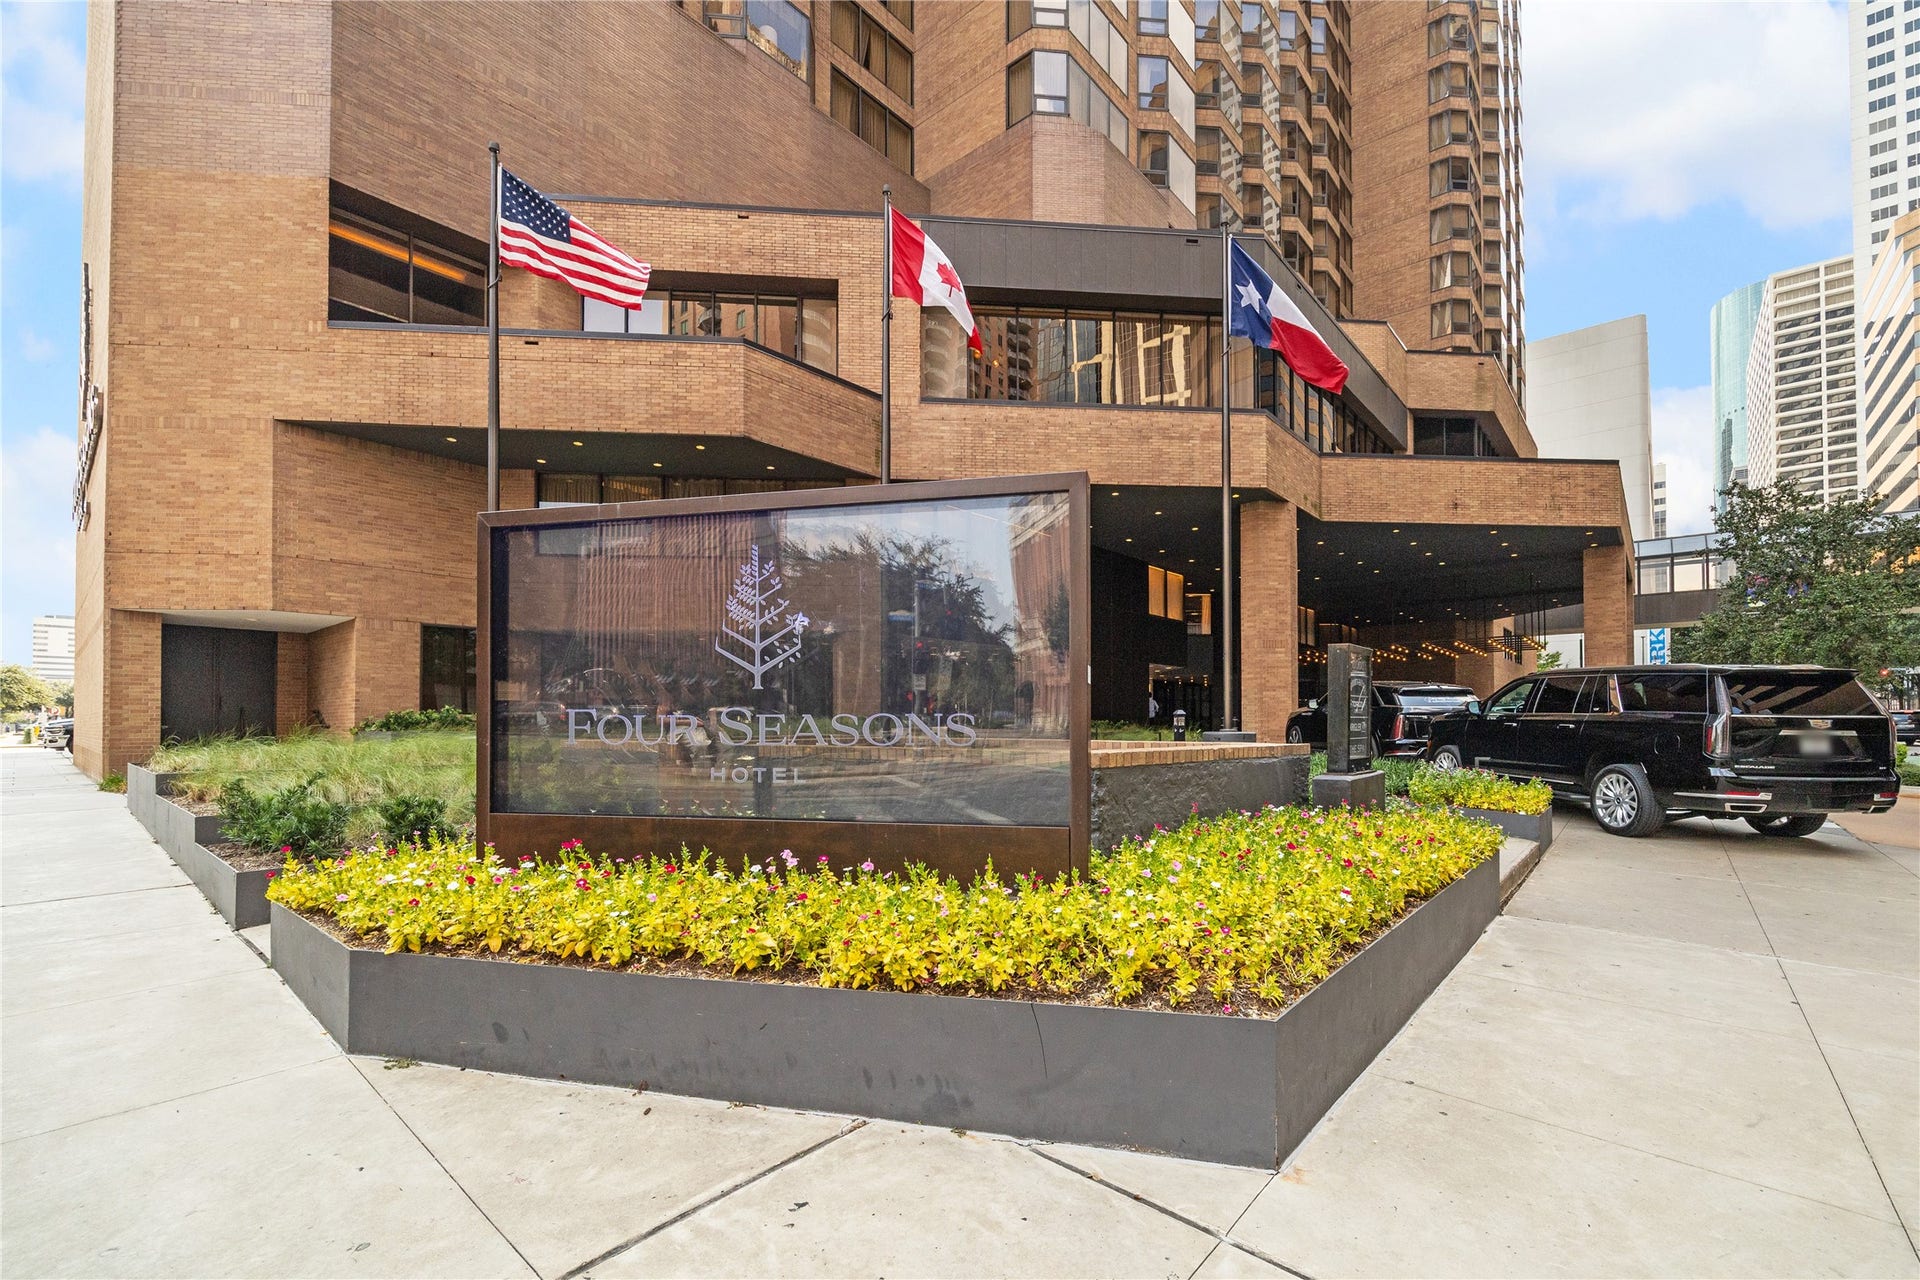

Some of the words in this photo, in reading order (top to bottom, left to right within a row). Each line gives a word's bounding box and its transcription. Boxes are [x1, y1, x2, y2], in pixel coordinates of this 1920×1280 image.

[566, 708, 700, 746] FOUR
[718, 706, 977, 747] SEASONS
[710, 767, 807, 784] HOTEL
